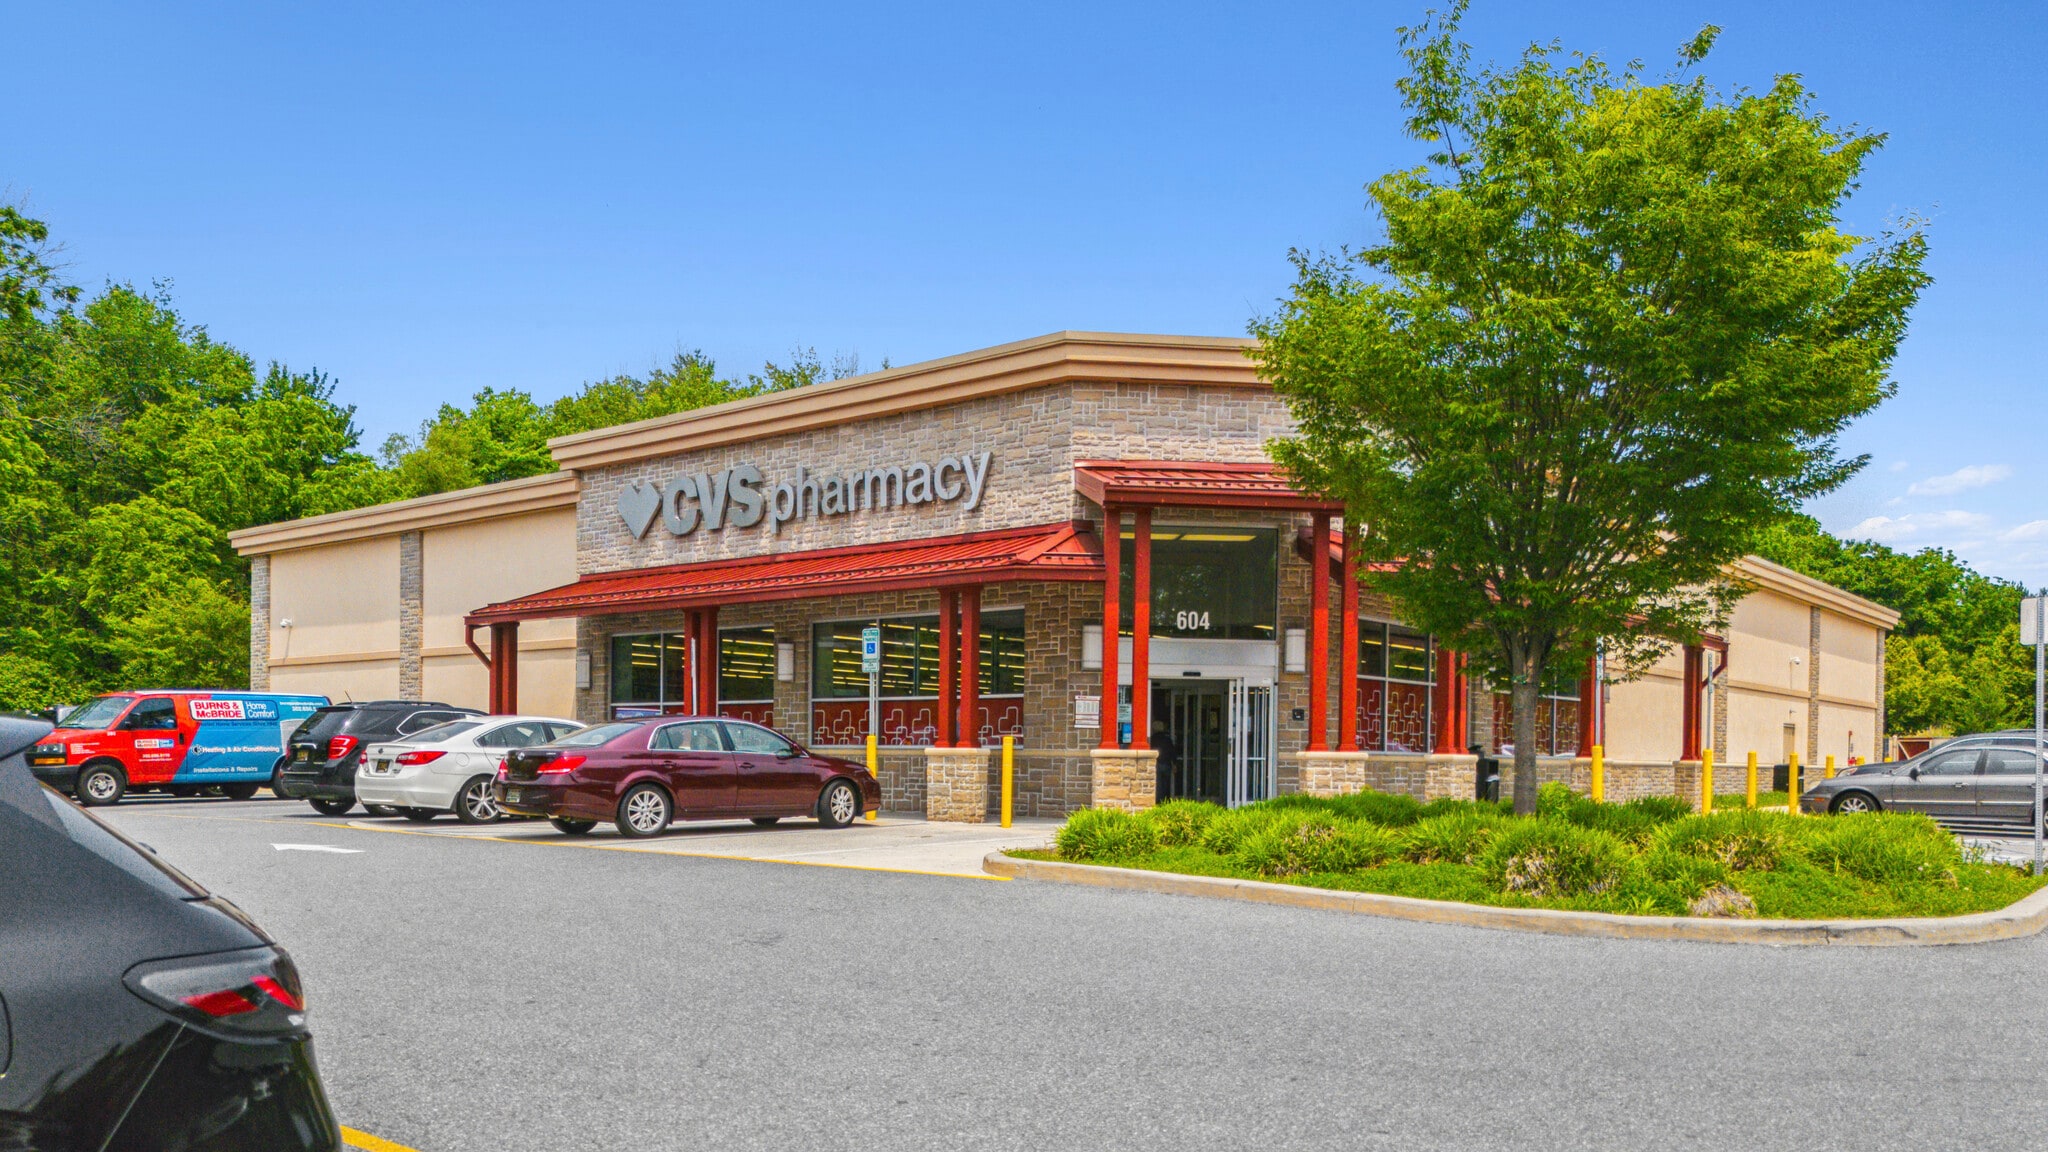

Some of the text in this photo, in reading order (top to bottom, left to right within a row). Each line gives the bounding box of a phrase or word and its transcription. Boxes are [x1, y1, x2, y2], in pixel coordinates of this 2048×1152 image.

[662, 451, 993, 536] CVS pharmacy
[1176, 610, 1210, 630] 604
[194, 702, 240, 710] BURNS &
[245, 702, 267, 710] Home
[196, 710, 243, 718] McBRIDE
[247, 709, 276, 719] Comfort
[202, 746, 226, 754] Heating
